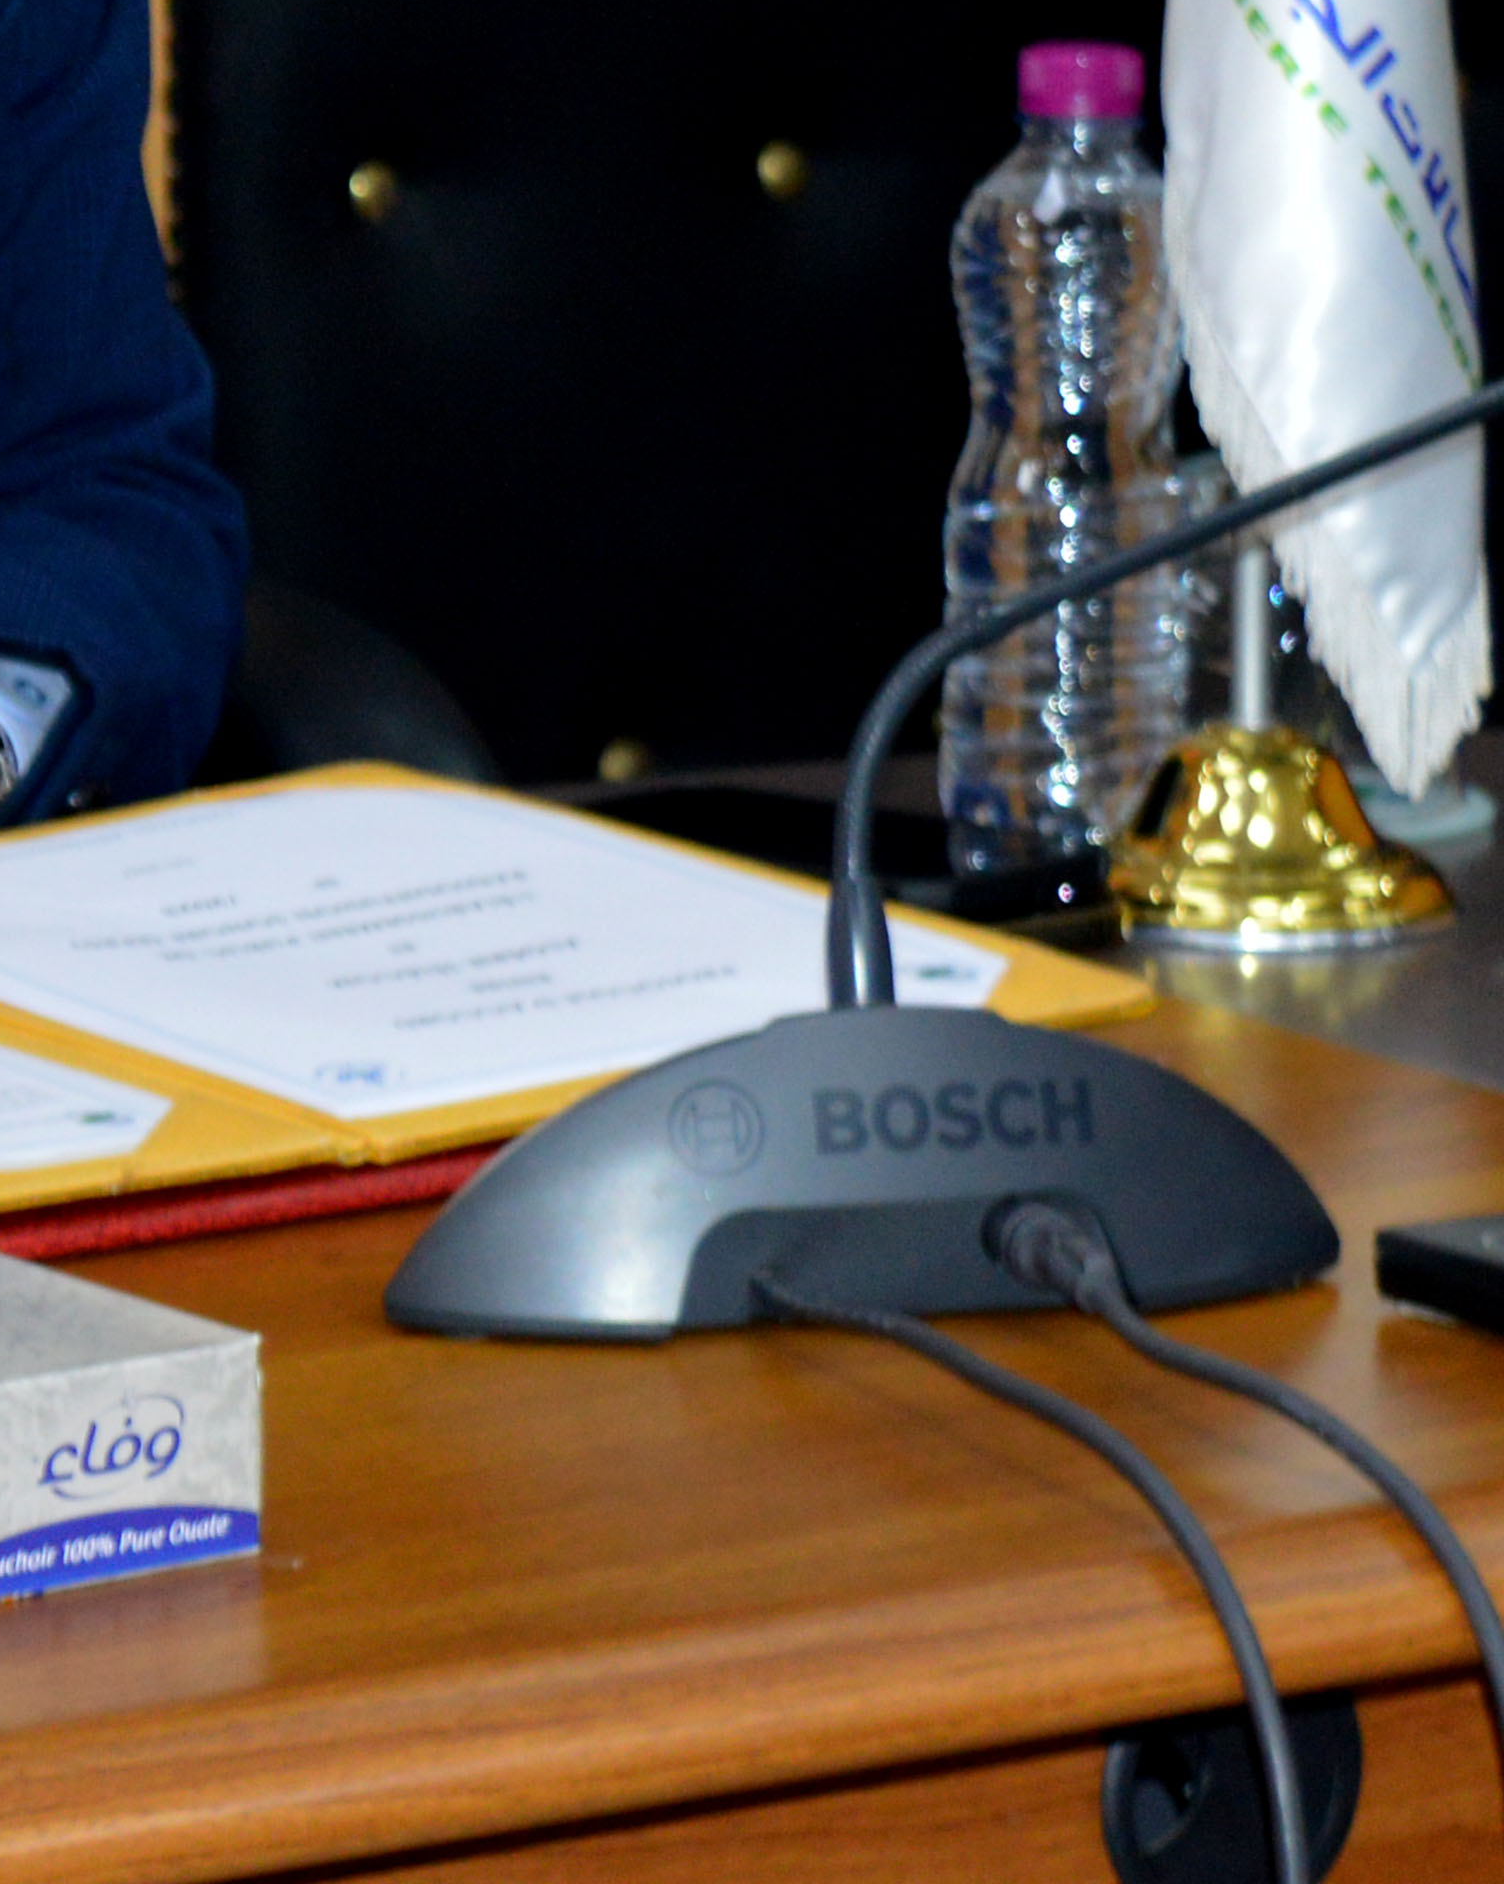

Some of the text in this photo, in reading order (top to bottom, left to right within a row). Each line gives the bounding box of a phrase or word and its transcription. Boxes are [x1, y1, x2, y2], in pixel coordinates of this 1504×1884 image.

[810, 1075, 1095, 1156] BOSCH
[37, 1415, 182, 1487] وفاء
[62, 1530, 116, 1566] 100%
[118, 1521, 167, 1555] Pure
[168, 1512, 234, 1547] Ouate
